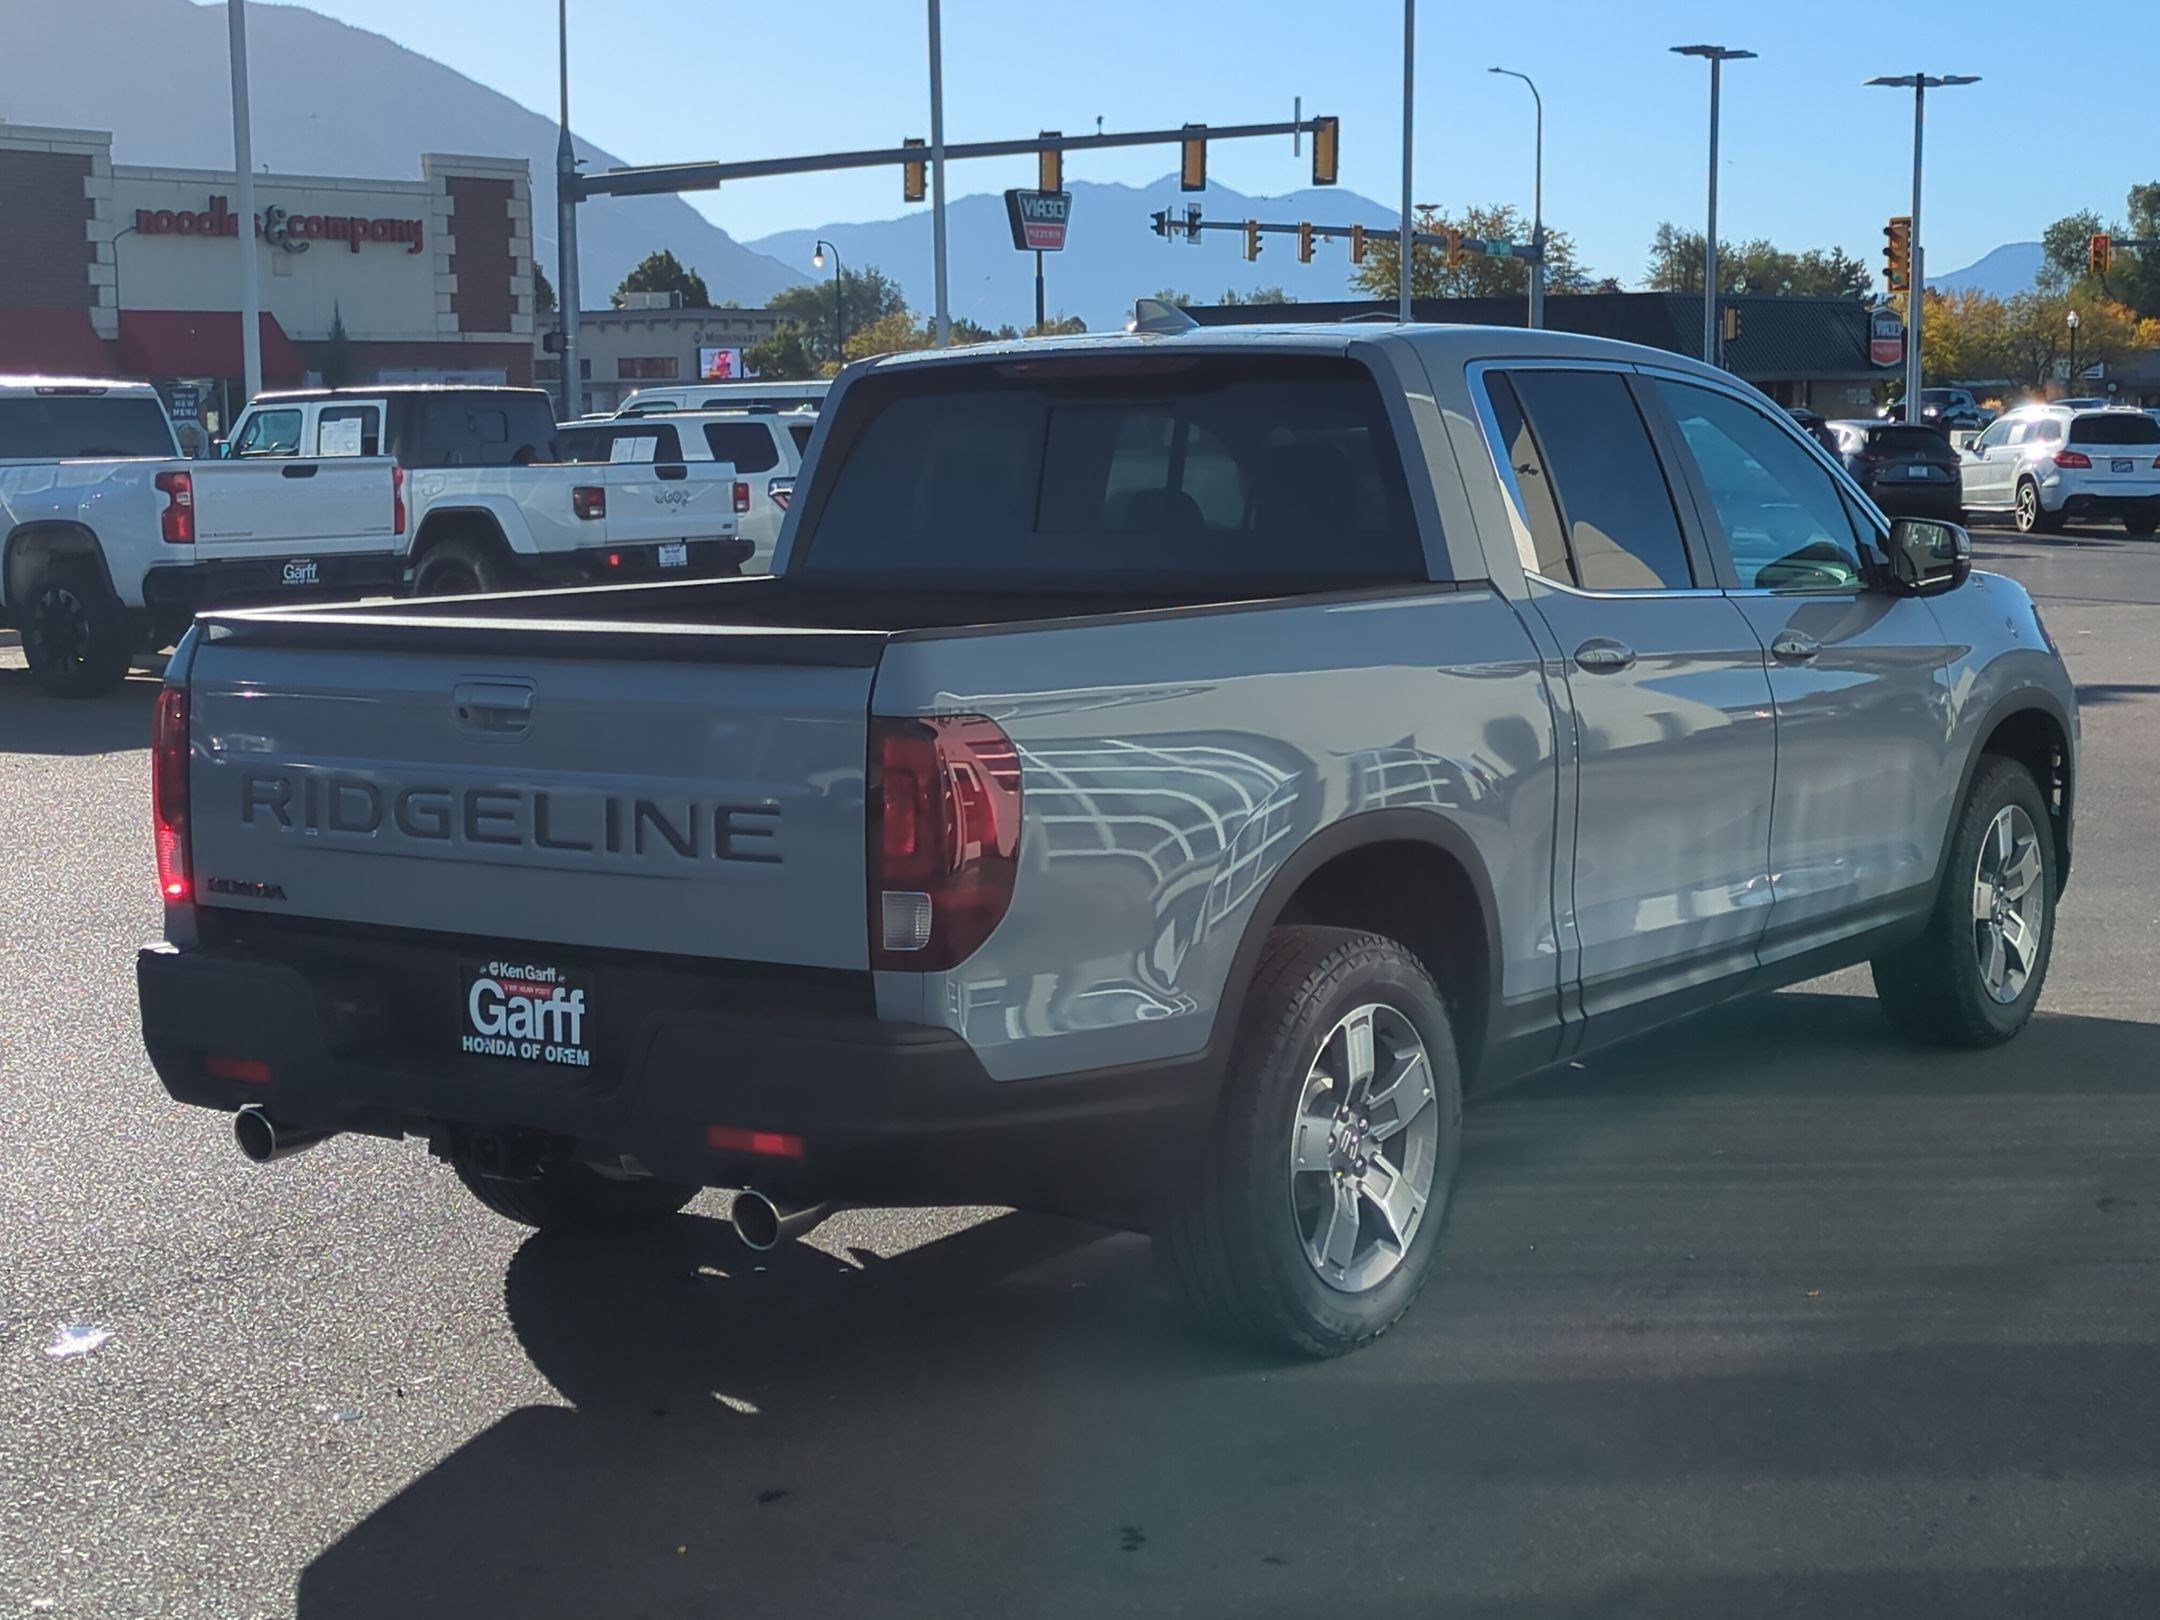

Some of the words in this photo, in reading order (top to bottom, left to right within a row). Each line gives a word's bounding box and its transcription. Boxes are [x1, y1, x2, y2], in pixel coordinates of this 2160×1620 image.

[286, 213, 423, 255] company
[283, 563, 318, 581] Garff
[240, 774, 784, 864] RIDGELINE
[500, 962, 525, 980] Ken
[525, 964, 556, 983] Garff
[469, 978, 585, 1045] Garff
[462, 1035, 517, 1057] HONDA
[520, 1042, 541, 1060] OF
[544, 1045, 590, 1066] OREM
